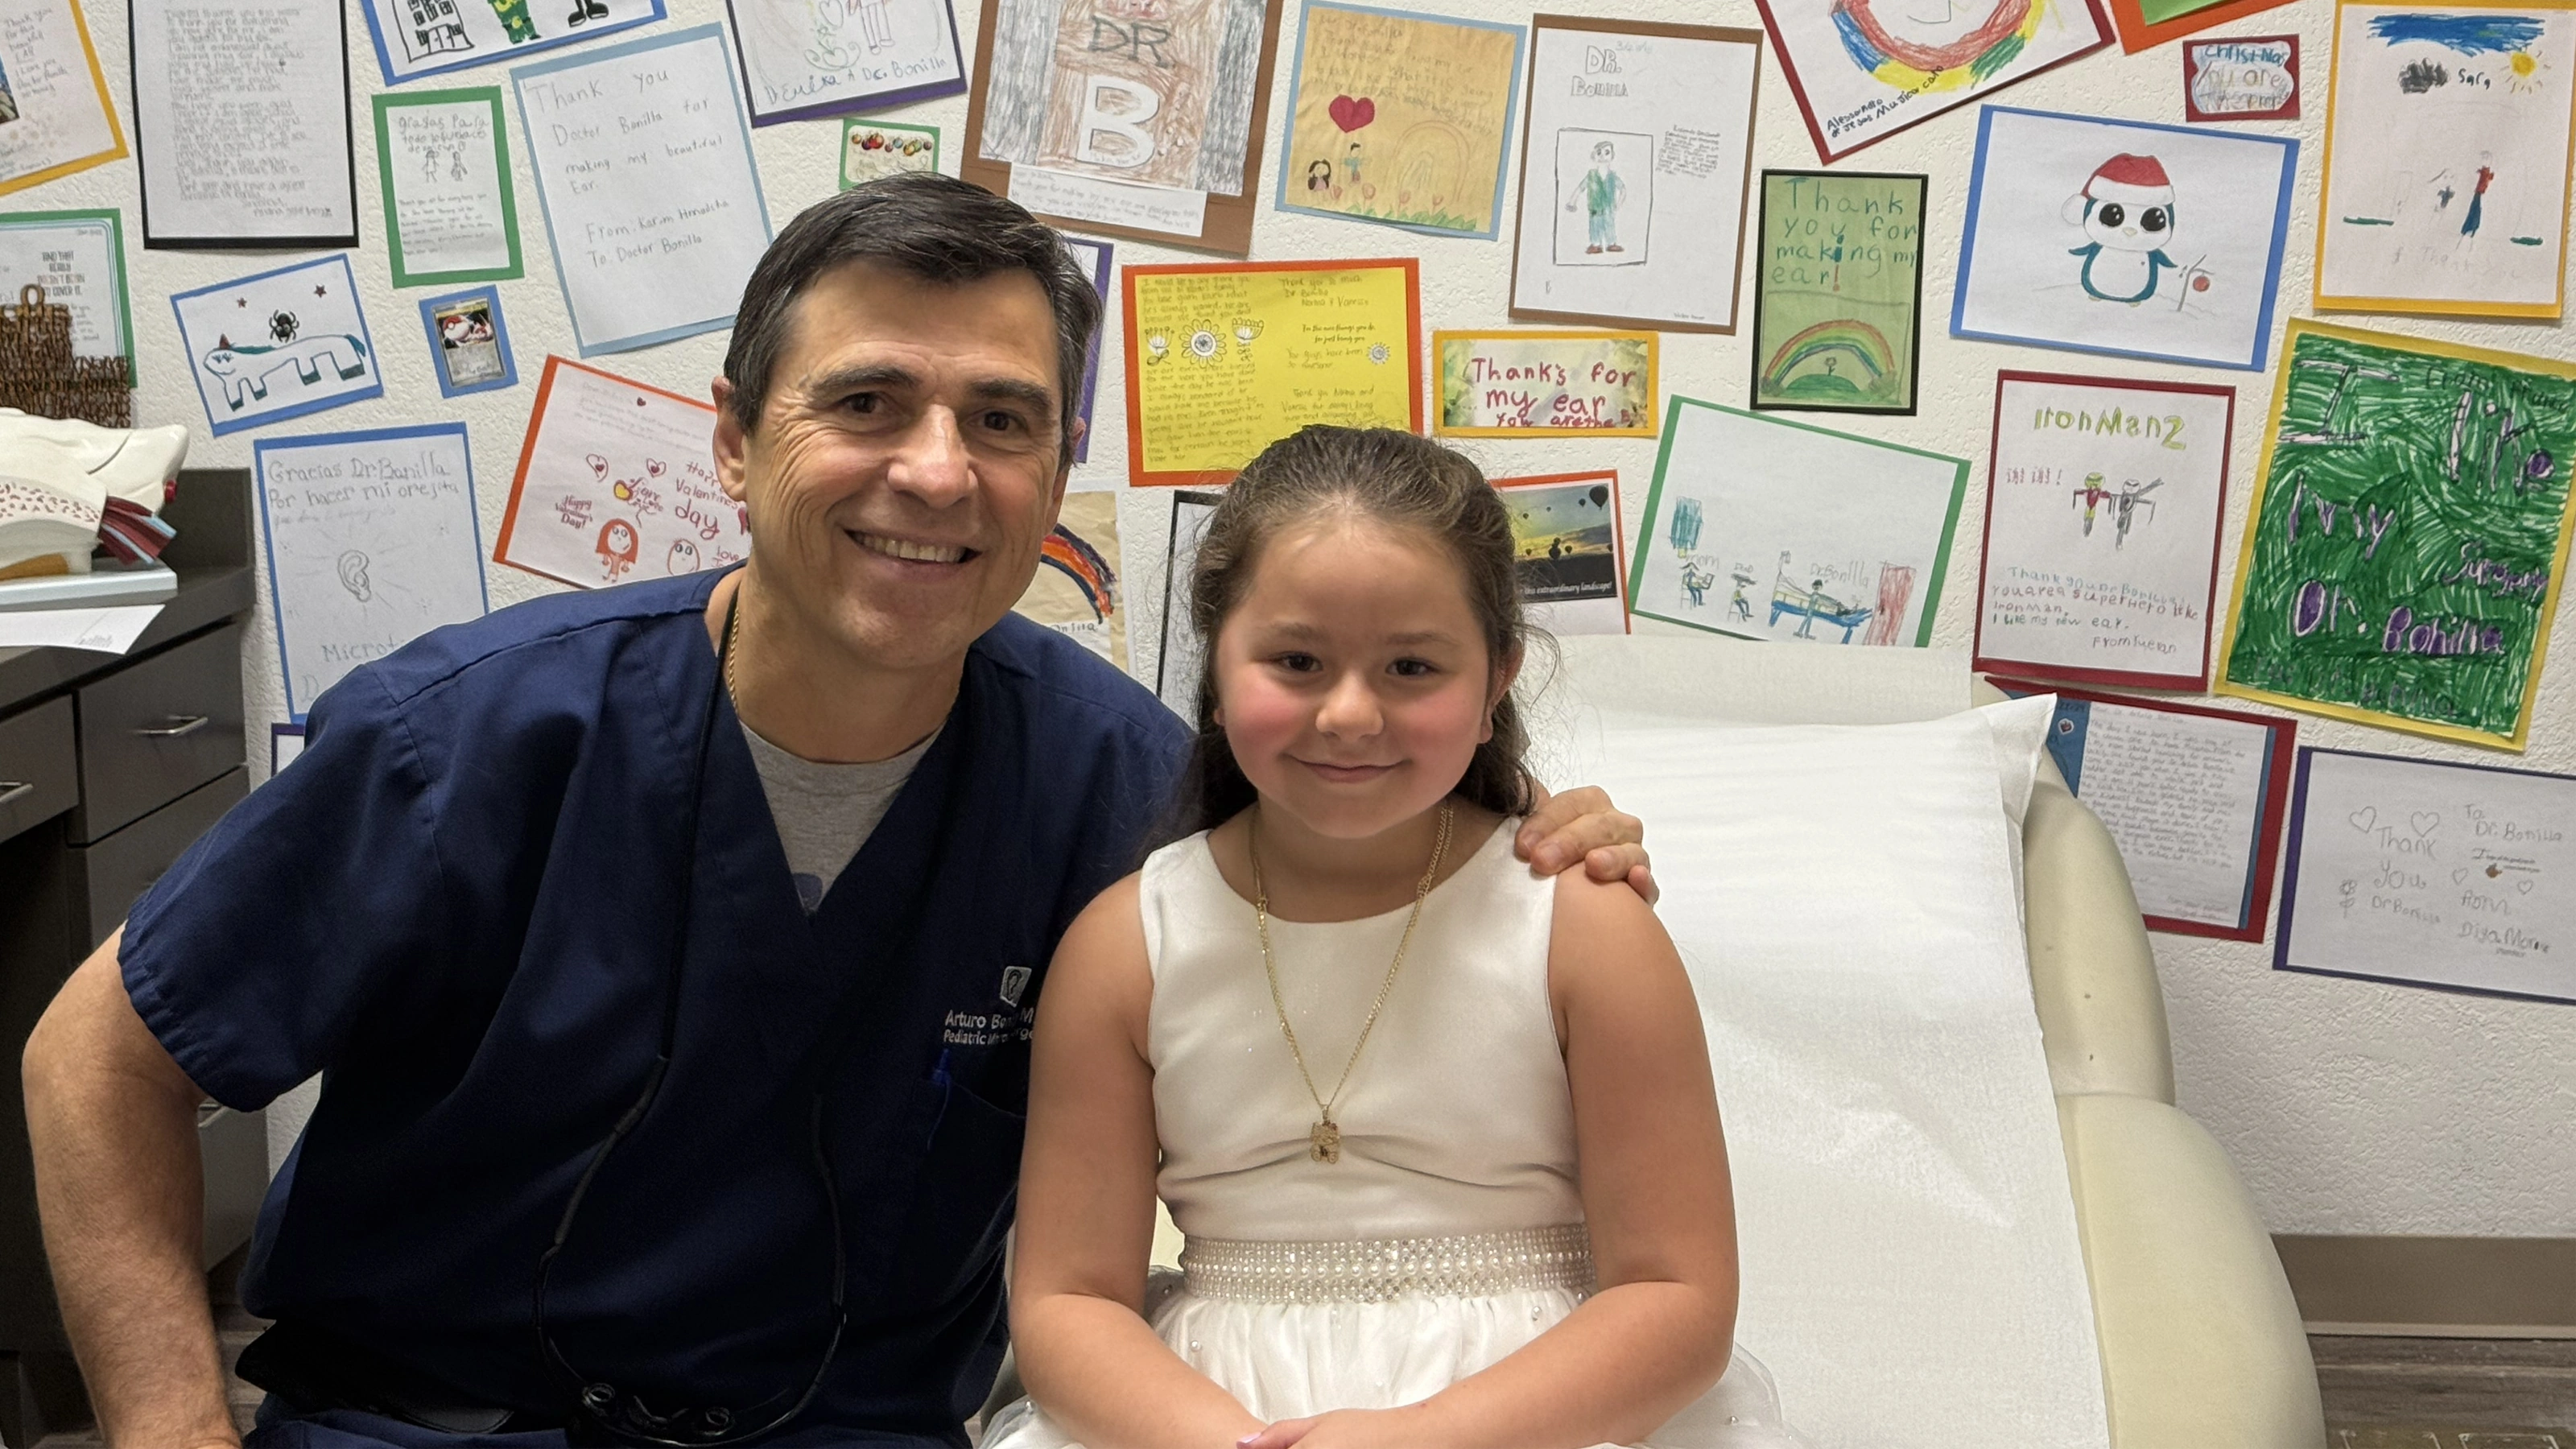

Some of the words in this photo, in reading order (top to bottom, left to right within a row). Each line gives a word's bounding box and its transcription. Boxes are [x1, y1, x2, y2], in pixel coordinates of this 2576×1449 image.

[1088, 14, 1171, 68] DR
[618, 110, 663, 134] Bonilla
[1076, 74, 1161, 168] B
[565, 159, 611, 175] making
[627, 153, 648, 165] my
[1785, 176, 1903, 215] Thank
[1785, 217, 1846, 238] you
[1870, 216, 1917, 241] for
[1777, 239, 1881, 279] making
[1591, 361, 1637, 387] for
[1486, 389, 1539, 419] my
[1553, 393, 1606, 419] ear
[362, 481, 391, 501] mi
[675, 498, 720, 542] day
[945, 1009, 987, 1029] Arturo
[943, 1029, 988, 1046] Pediatric
